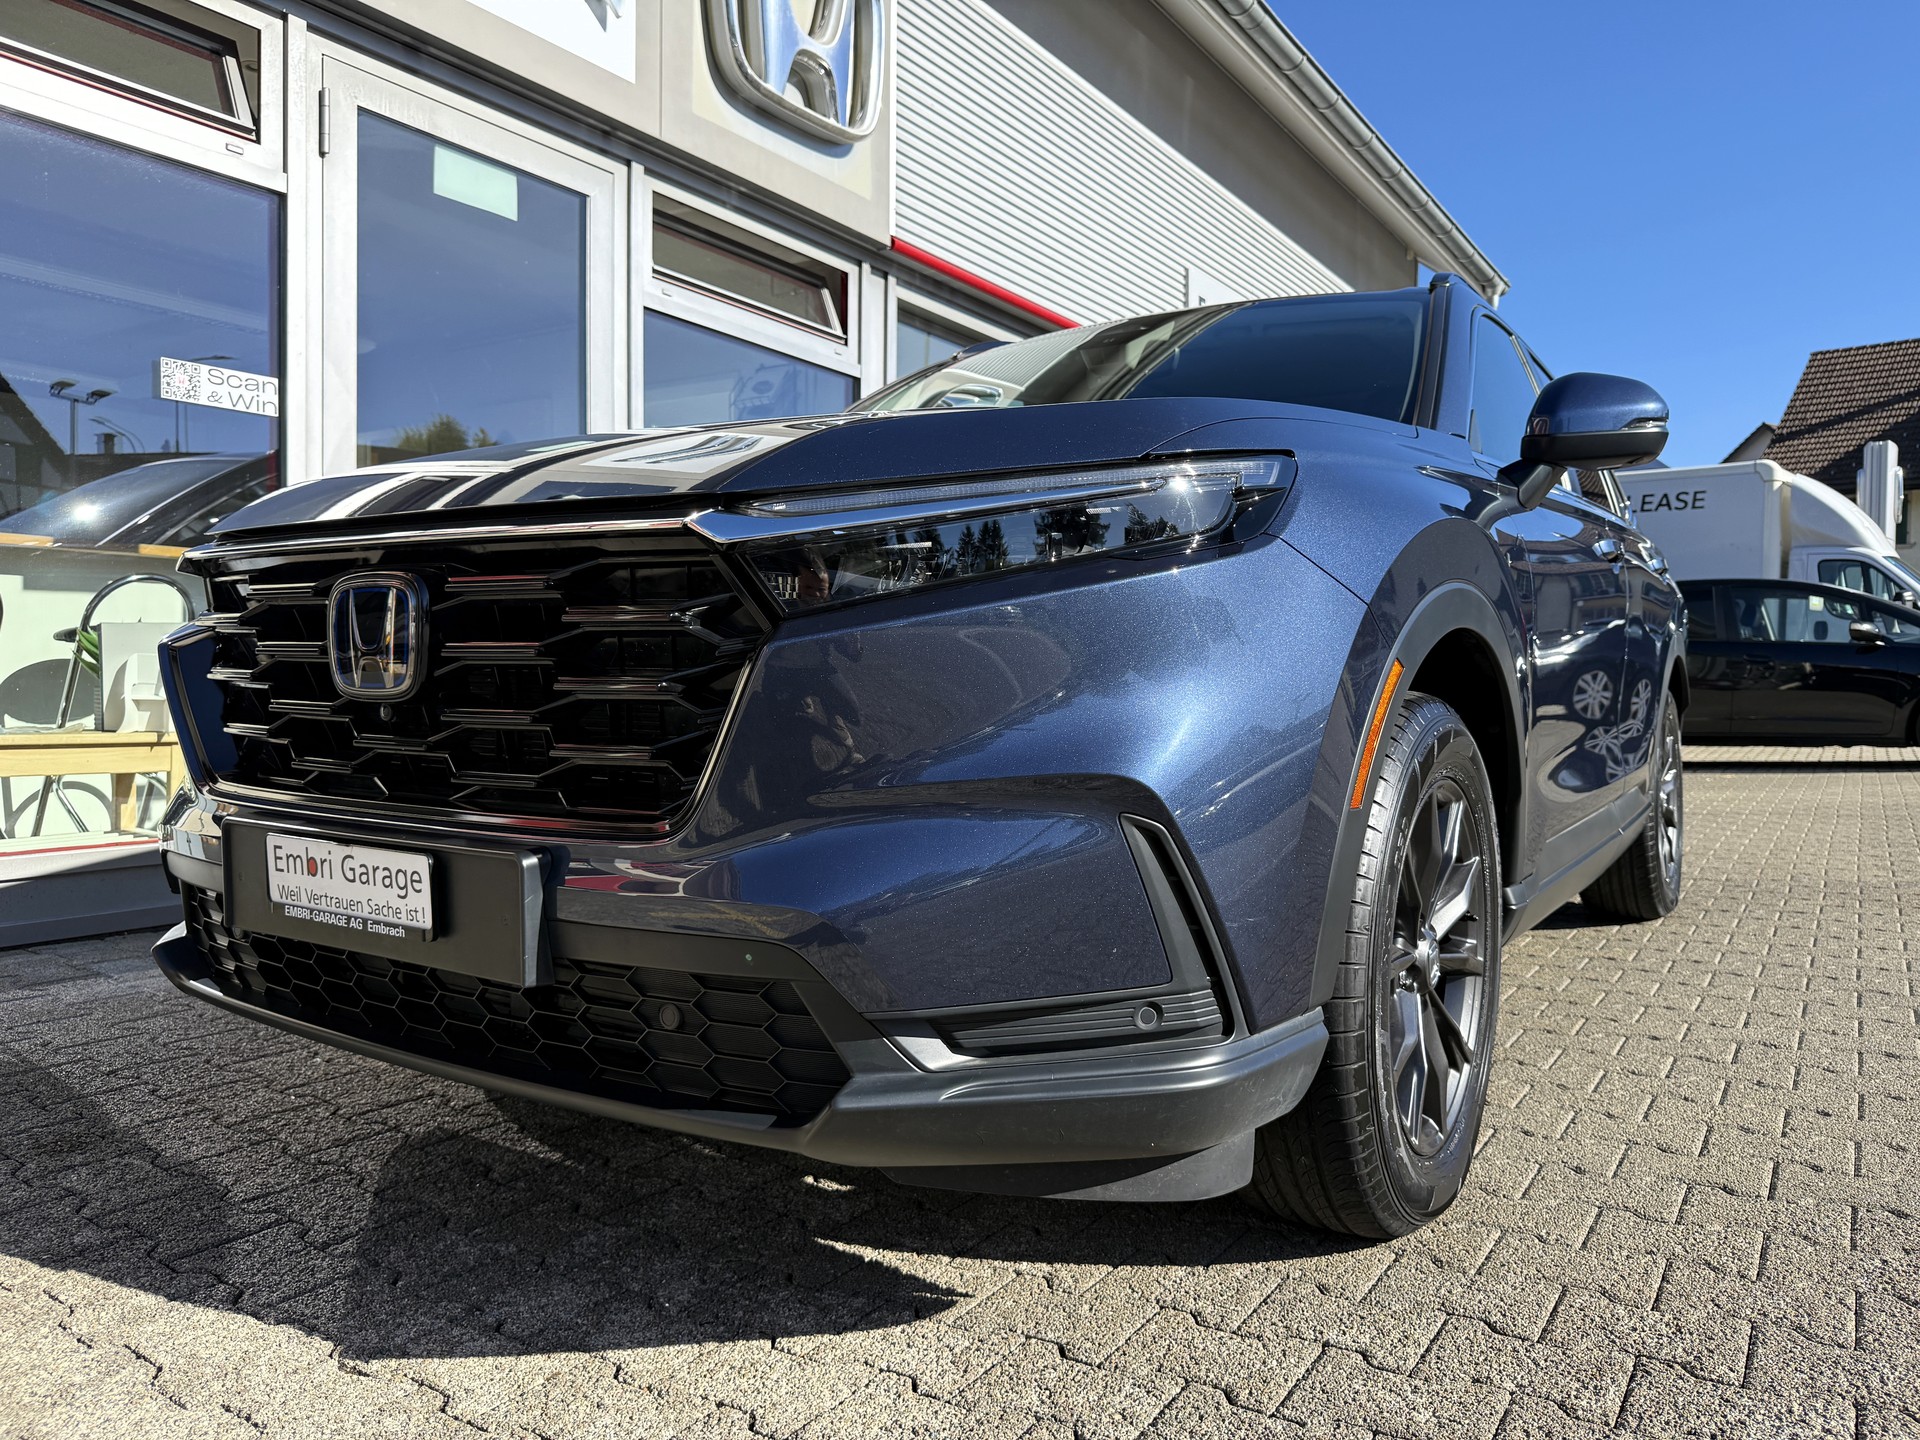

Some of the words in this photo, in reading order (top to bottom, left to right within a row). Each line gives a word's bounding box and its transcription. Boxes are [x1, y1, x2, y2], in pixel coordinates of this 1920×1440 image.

[207, 368, 278, 396] Scan
[207, 391, 223, 404] &
[228, 391, 278, 415] Win
[273, 844, 333, 880] Embri
[341, 854, 423, 900] Garage
[277, 884, 302, 902] Weil
[305, 888, 363, 913] Vertrauen
[367, 898, 402, 920] Sache
[284, 904, 348, 927] EMBRI-GARAGE
[349, 917, 363, 930] AG
[367, 920, 406, 938] Embrach
